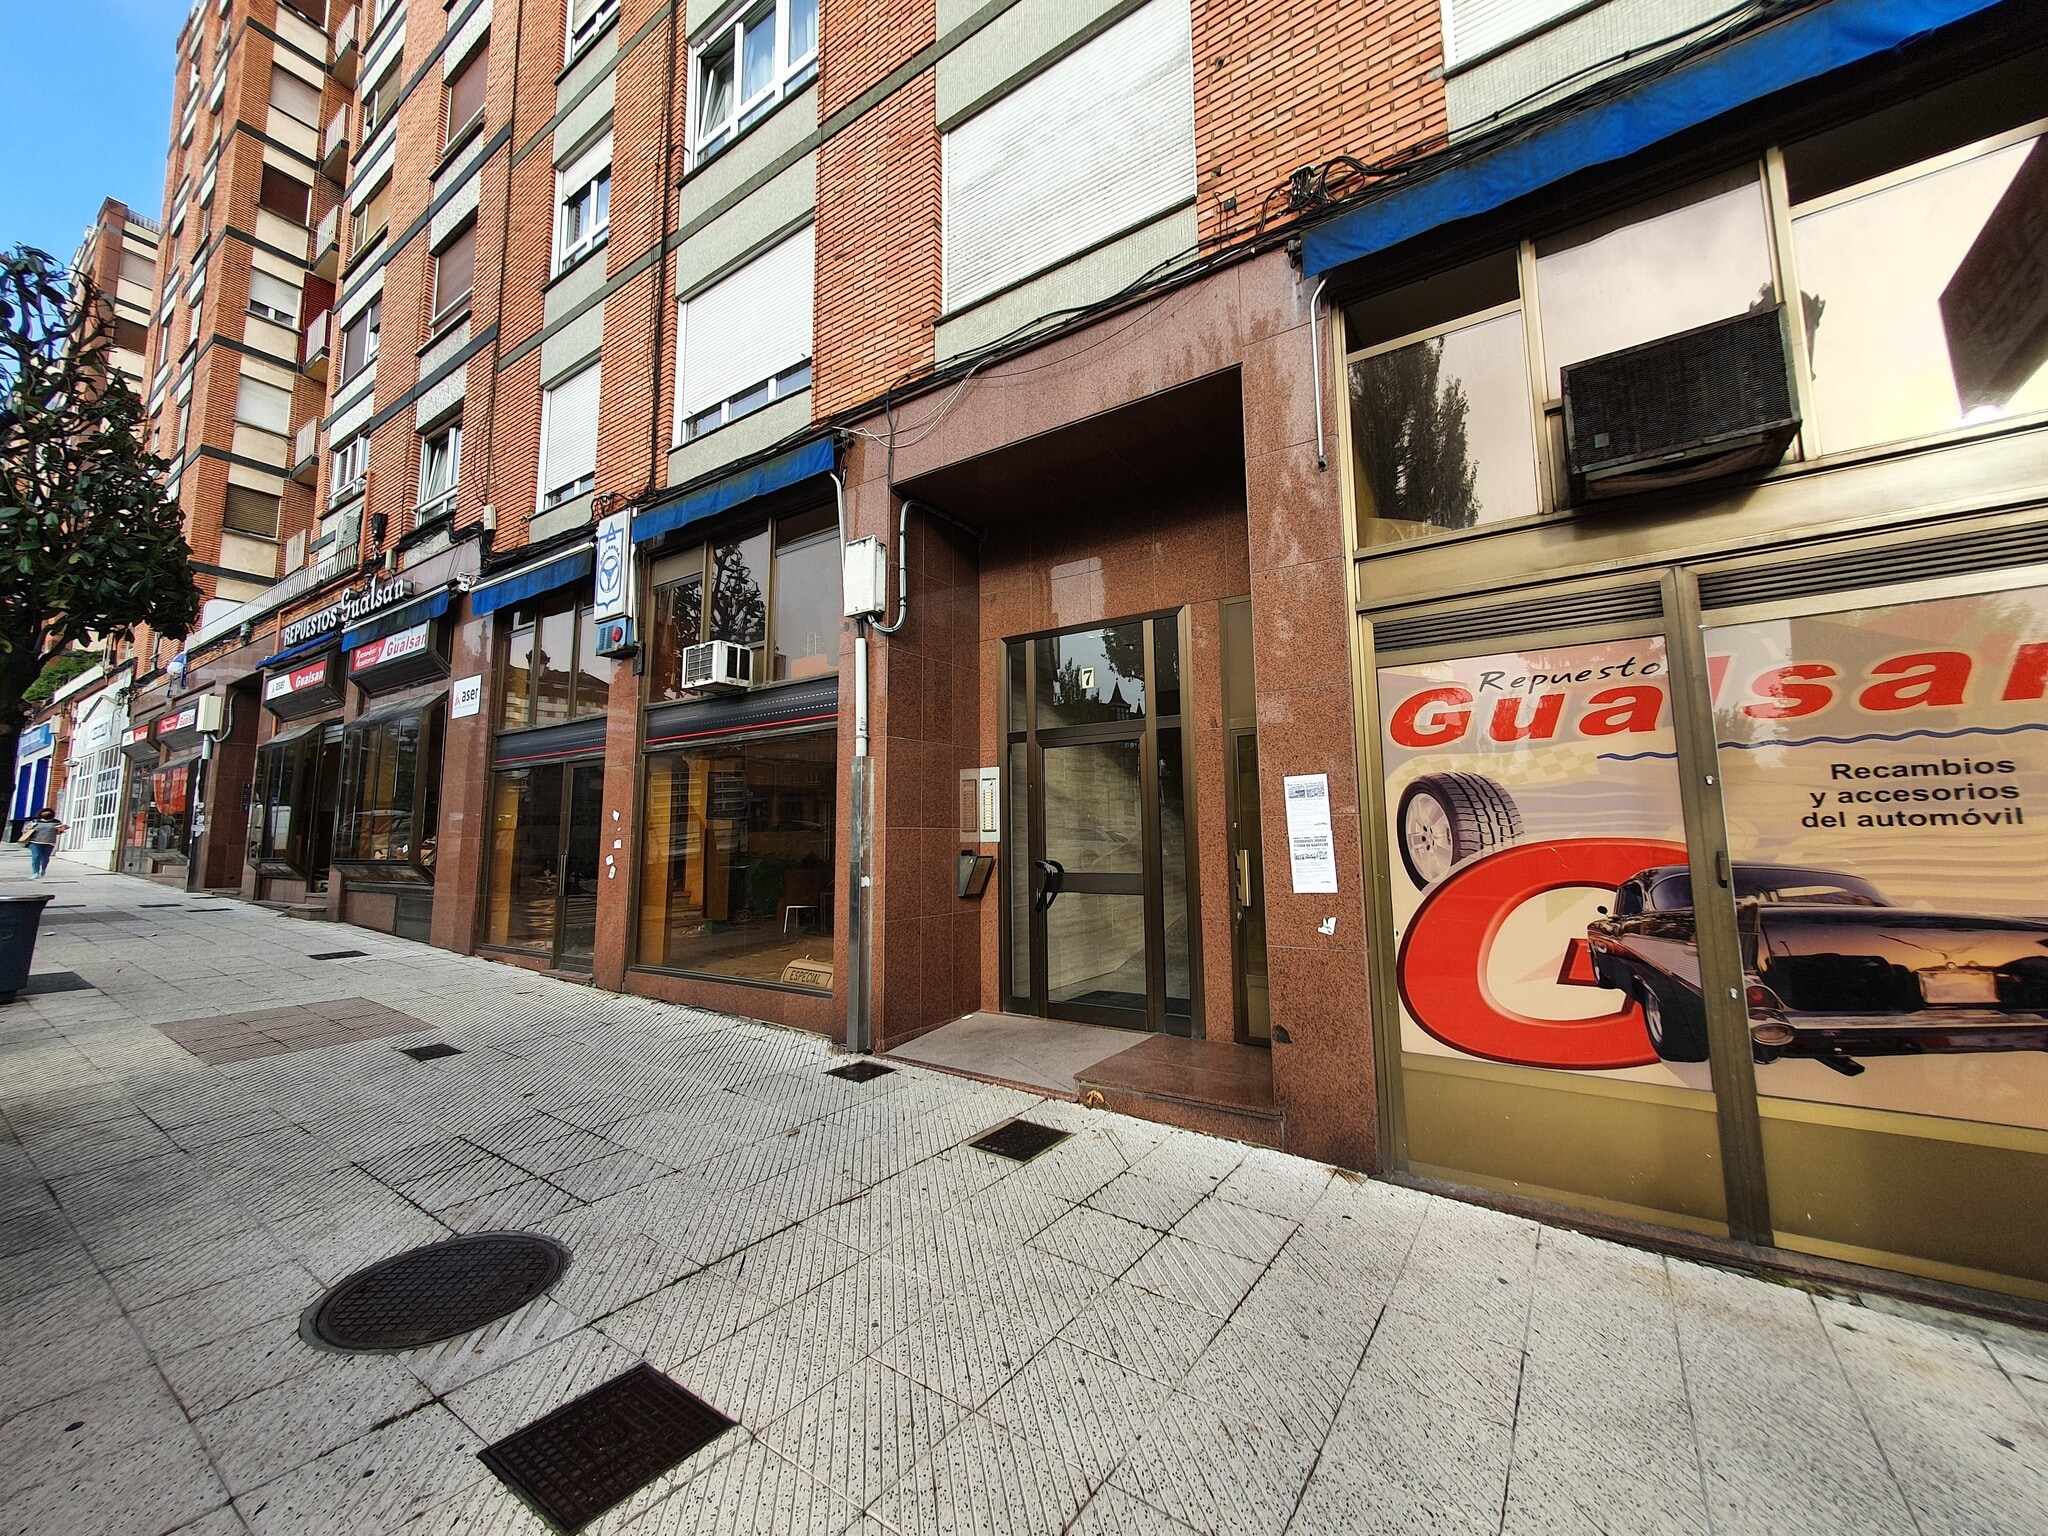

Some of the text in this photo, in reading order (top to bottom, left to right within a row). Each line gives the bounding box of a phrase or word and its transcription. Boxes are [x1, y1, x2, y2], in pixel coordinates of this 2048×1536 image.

[284, 576, 405, 647] REPUESTOS Gualsan
[387, 634, 427, 657] Gualsan
[295, 670, 324, 688] Gualsan
[1083, 669, 1093, 686] 7
[1478, 655, 1669, 695] Repuesto
[461, 688, 479, 702] aser
[1390, 642, 2048, 747] Guasa
[1831, 758, 2017, 780] Recambios
[1809, 782, 2020, 808] y accesorios
[1801, 807, 2024, 828] del automóvil
[790, 970, 821, 985] ESPECIAL
